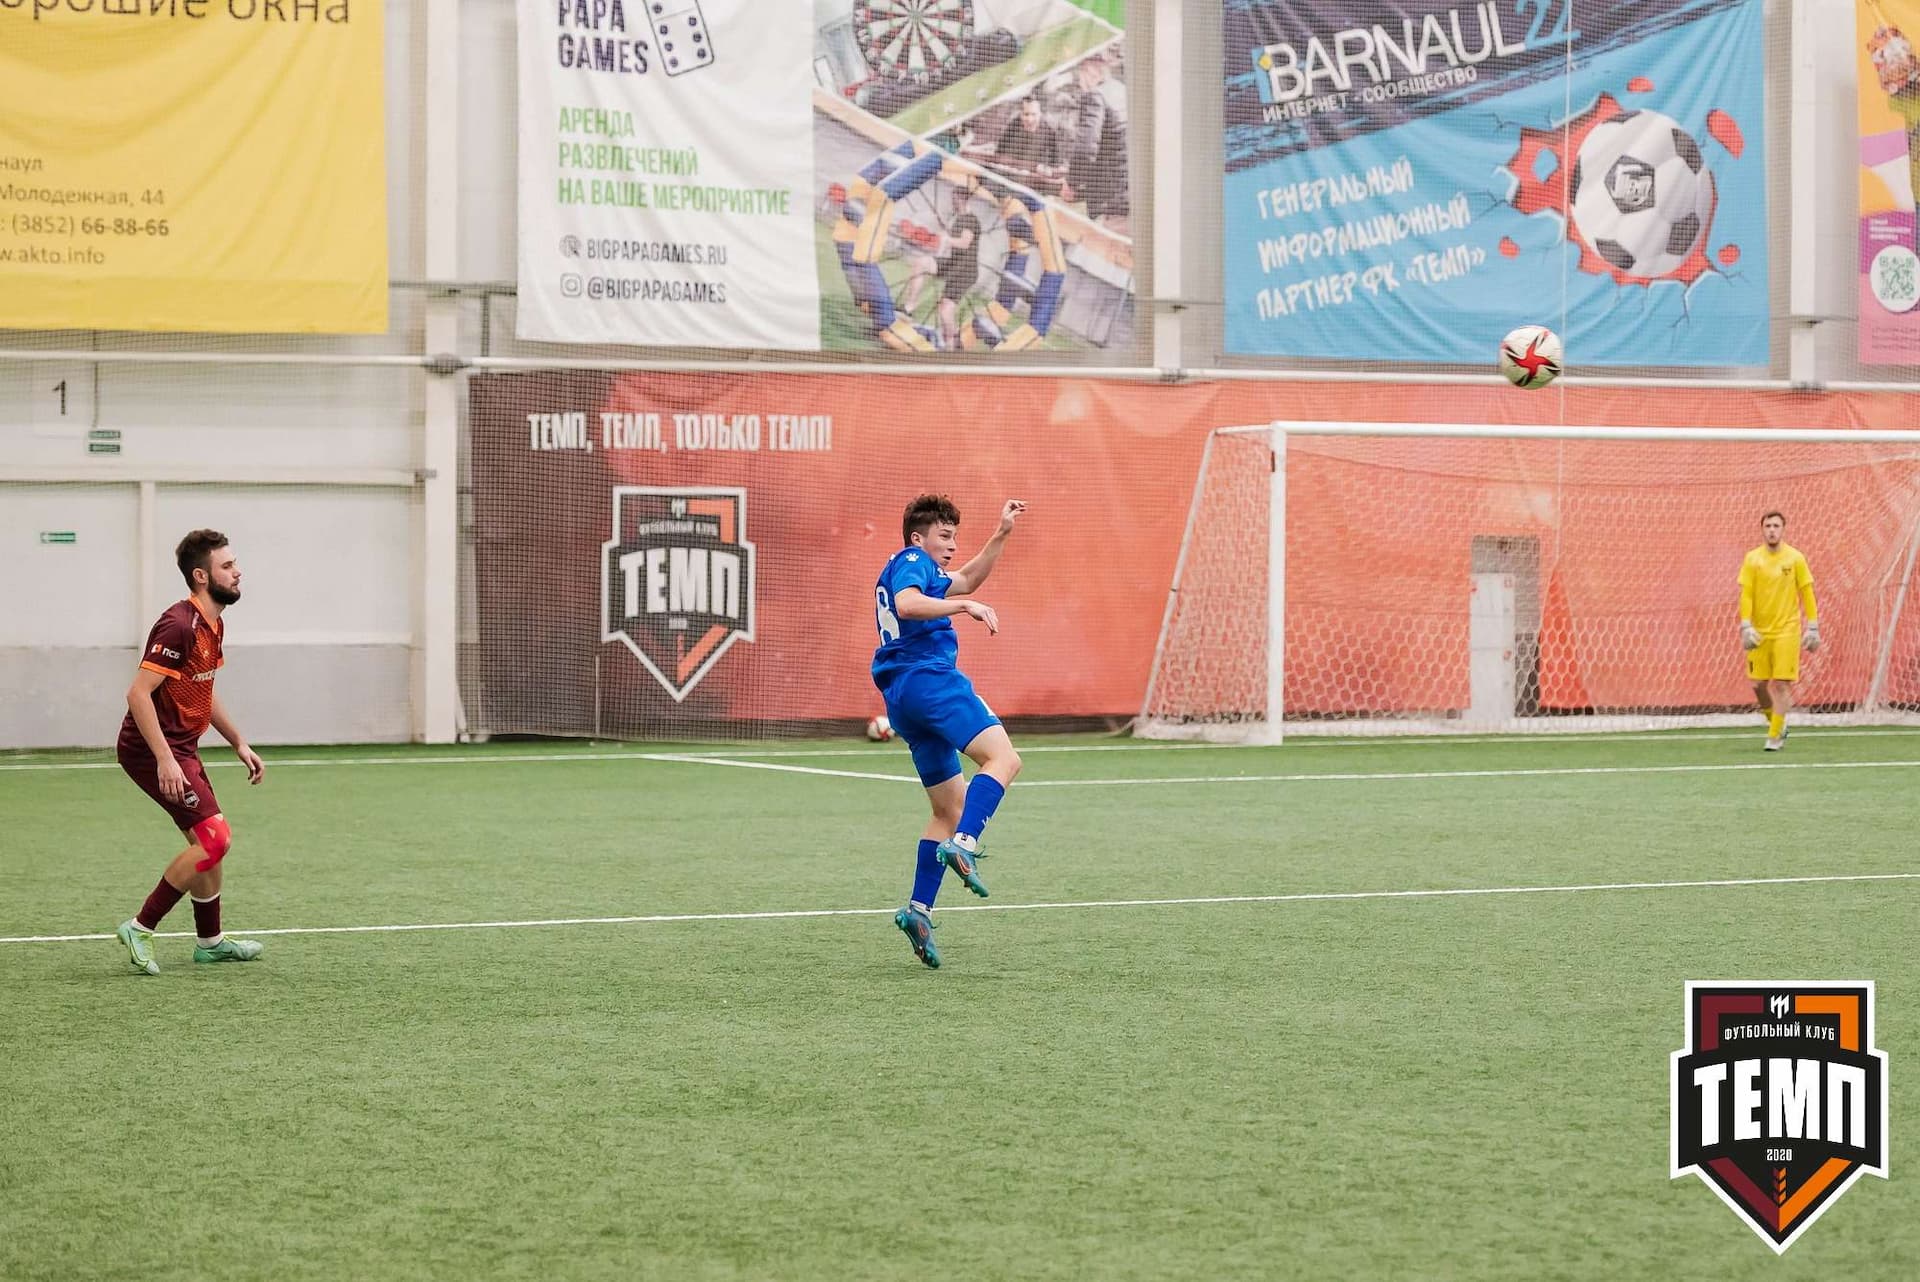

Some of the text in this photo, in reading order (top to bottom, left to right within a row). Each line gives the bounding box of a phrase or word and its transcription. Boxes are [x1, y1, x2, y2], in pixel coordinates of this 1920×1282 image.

[228, 0, 349, 24] окна
[558, 0, 625, 33] PAPA
[558, 33, 649, 74] GAMES
[1262, 90, 1348, 123] ИНТЕРНЕТ
[1362, 65, 1477, 103] СООБЩЕСТВО
[558, 106, 636, 138] АРЕНДА
[558, 141, 698, 176] РАЗВЛЕЧЕНИЙ
[140, 188, 165, 205] 44
[558, 178, 791, 216] НА ВАШЕ МЕРОПРИЯТИЕ
[1257, 156, 1414, 219] ГЕНЕРАЛЬНЫЙ
[12, 213, 75, 237] (3852)
[81, 217, 170, 237] 66-88-66
[1257, 191, 1472, 274] ИНФОРМАЦИОННЫЙ
[586, 238, 728, 266] BIGPAPAGAMES.RU
[586, 276, 728, 304] @BIGPAPAGAMES
[1256, 245, 1487, 321] ПАРТНЕР ФК «ТЕМП»
[52, 379, 67, 416] 1
[527, 412, 833, 453] ТЕМП, ТЕМП, ТОЛЬКО ТЕМП!
[618, 547, 741, 619] ТЕМП
